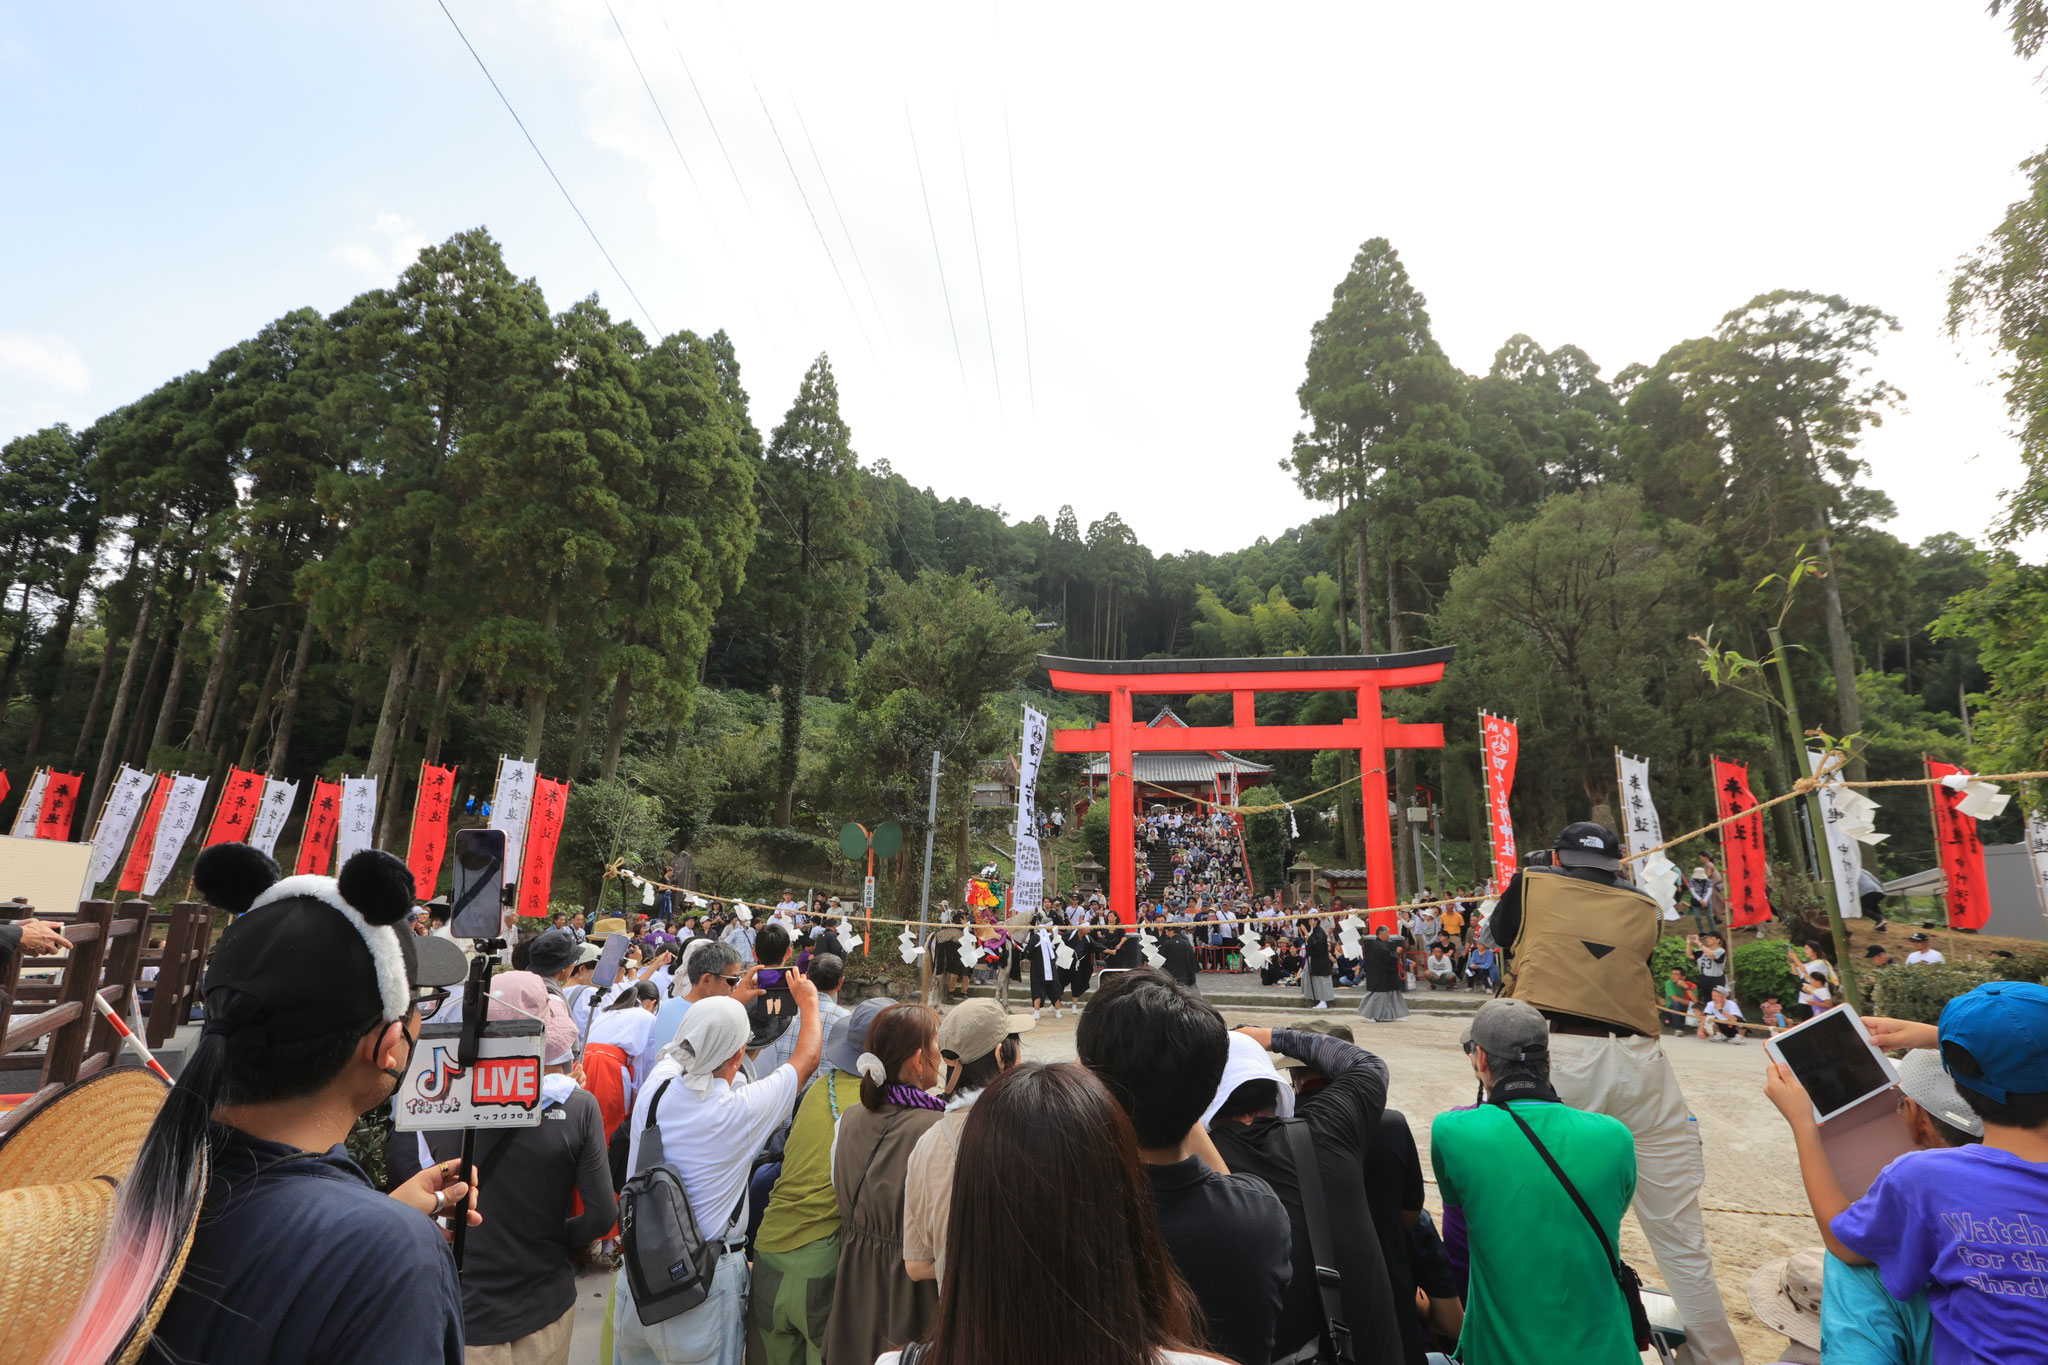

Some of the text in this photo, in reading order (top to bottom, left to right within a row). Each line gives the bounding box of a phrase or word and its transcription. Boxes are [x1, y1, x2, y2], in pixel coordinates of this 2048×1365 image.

[477, 1066, 534, 1097] LIVE
[406, 1098, 460, 1115] TikTok
[1940, 1212, 2048, 1246] Watch
[1957, 1246, 2005, 1269] for
[1964, 1272, 2048, 1298] shad
